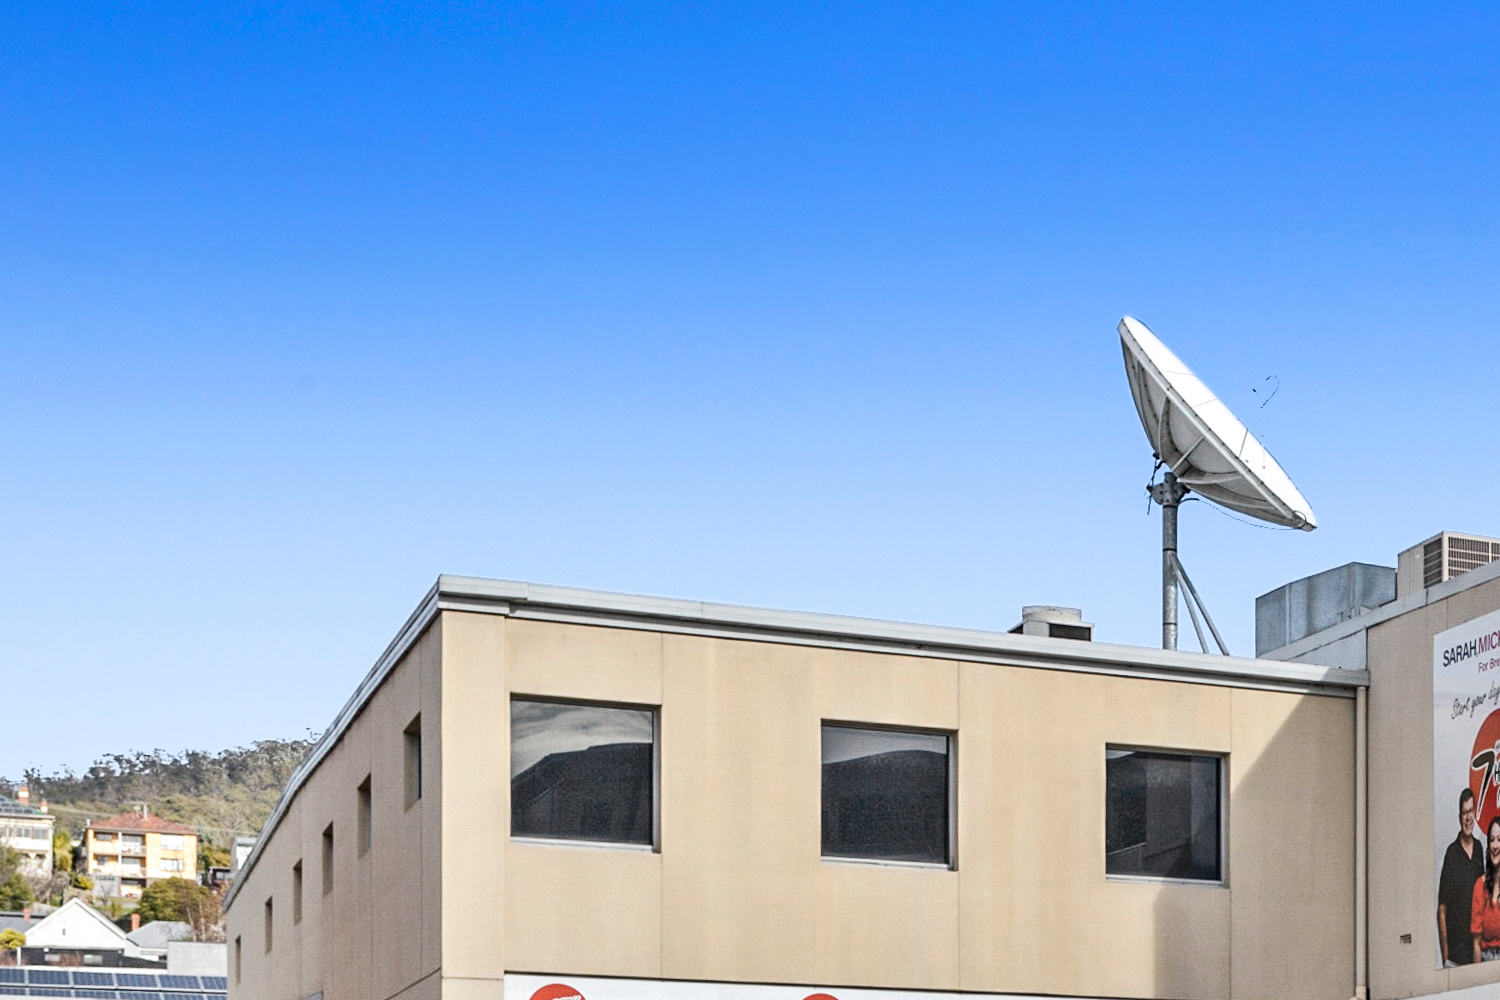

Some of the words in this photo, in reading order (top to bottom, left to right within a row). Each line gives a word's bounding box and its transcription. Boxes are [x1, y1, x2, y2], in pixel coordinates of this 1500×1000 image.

[1478, 661, 1488, 673] For
[1451, 698, 1470, 720] Start
[1488, 680, 1500, 706] day
